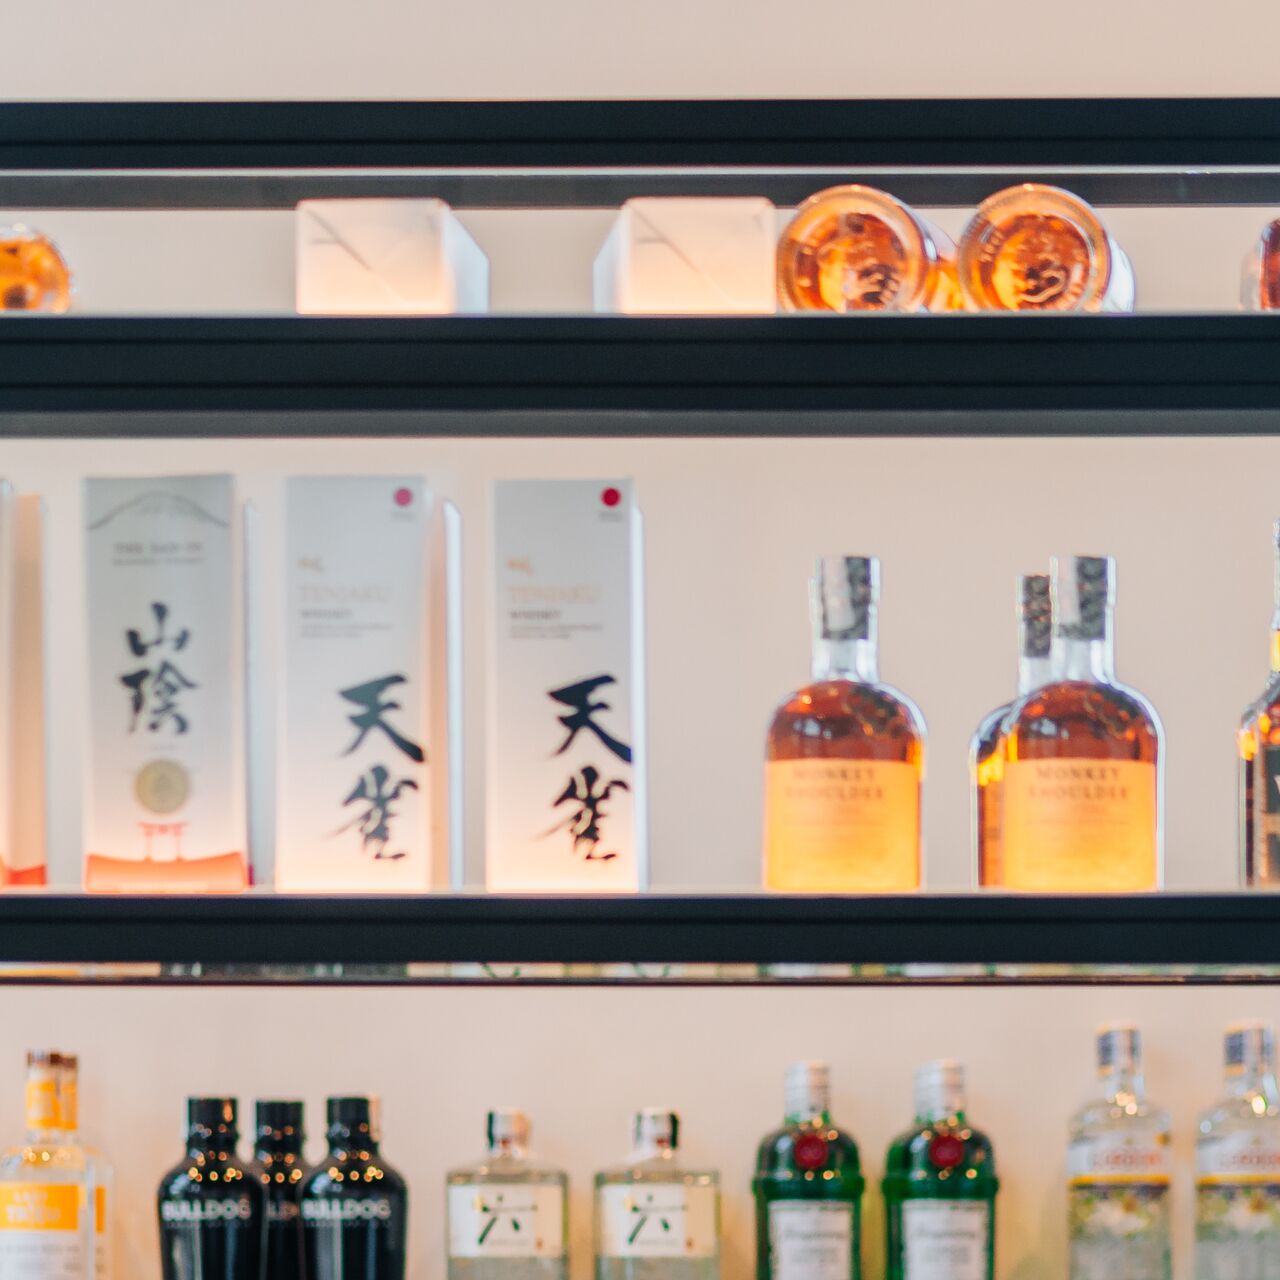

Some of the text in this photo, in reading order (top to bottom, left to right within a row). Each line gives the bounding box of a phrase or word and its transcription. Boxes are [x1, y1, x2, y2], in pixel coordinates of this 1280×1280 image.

[1035, 765, 1122, 781] MONKEY
[161, 1198, 252, 1222] BULLDOG
[301, 1197, 392, 1221] BULLDOG
[478, 1193, 538, 1246] 六
[628, 1193, 688, 1246] 六
